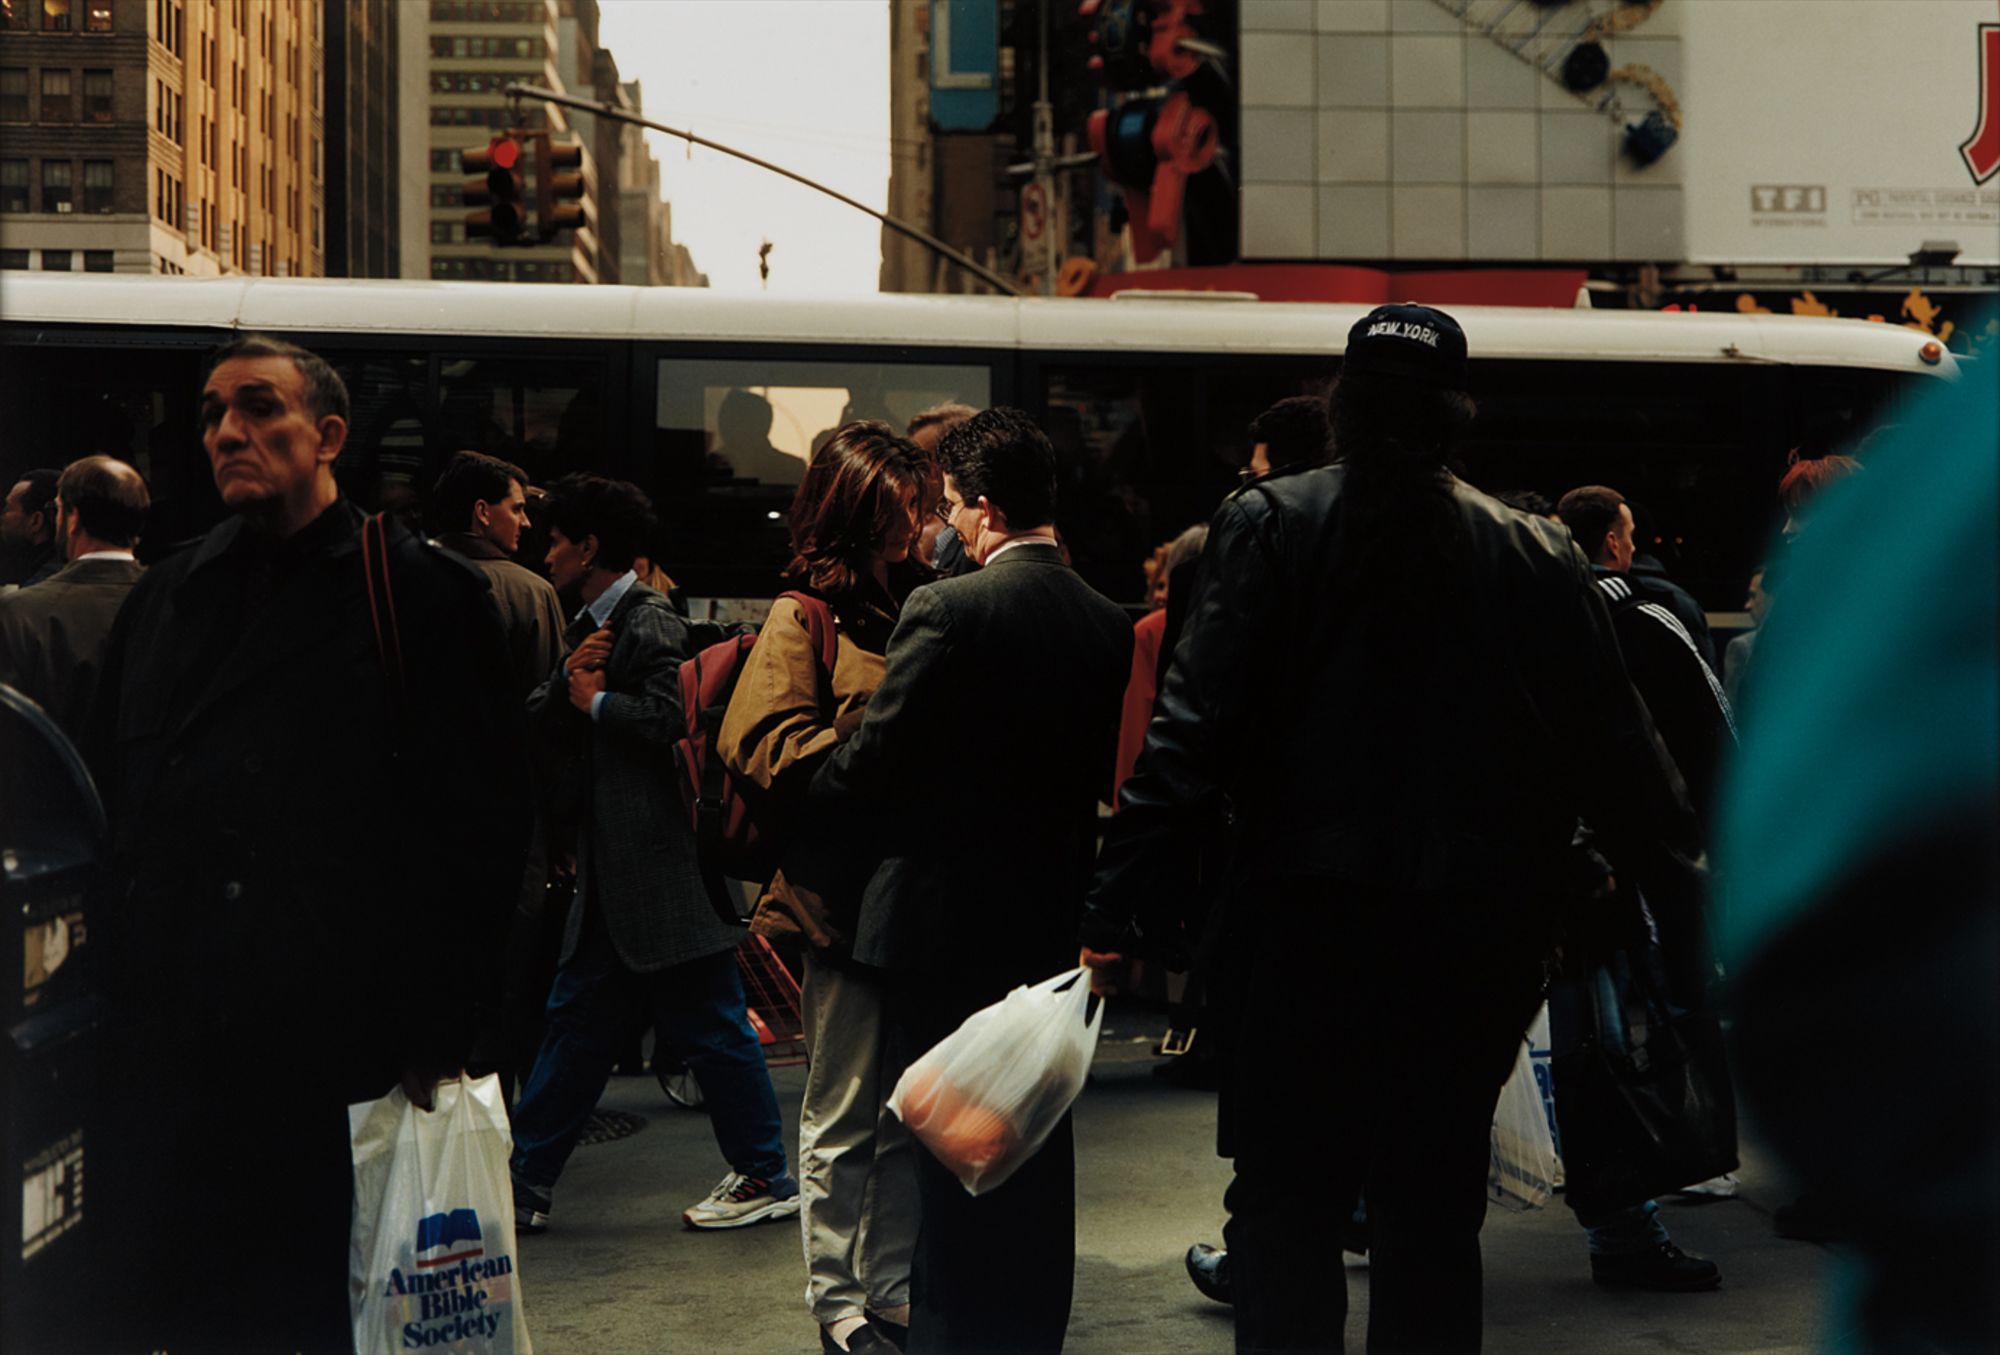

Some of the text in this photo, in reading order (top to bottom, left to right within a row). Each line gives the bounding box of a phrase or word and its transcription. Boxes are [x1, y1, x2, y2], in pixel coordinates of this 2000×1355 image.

[1367, 321, 1440, 348] NEW YORK
[383, 1255, 512, 1297] American
[420, 1285, 488, 1320] Bible
[403, 1313, 500, 1349] Society
